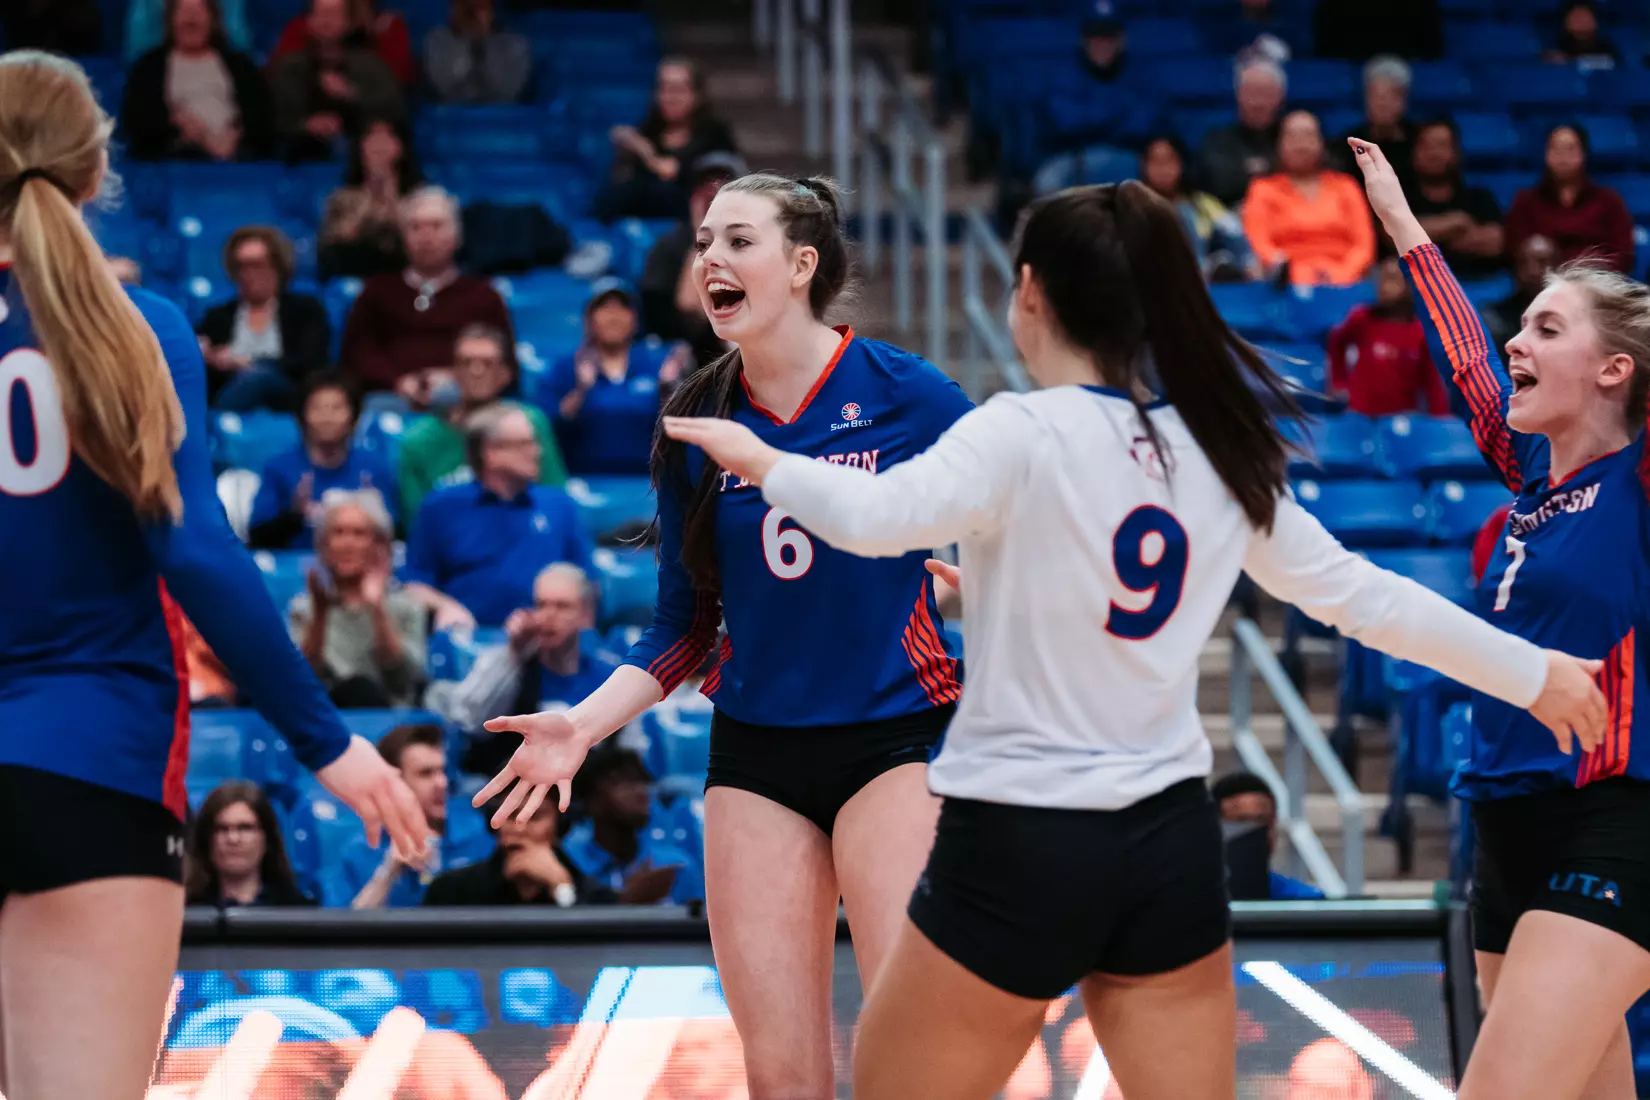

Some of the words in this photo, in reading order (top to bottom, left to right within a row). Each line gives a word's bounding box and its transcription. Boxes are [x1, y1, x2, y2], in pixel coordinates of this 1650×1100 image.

[761, 505, 814, 580] 6
[1104, 504, 1190, 641] 9
[1493, 536, 1527, 612] 7
[1548, 871, 1622, 907] UTA
